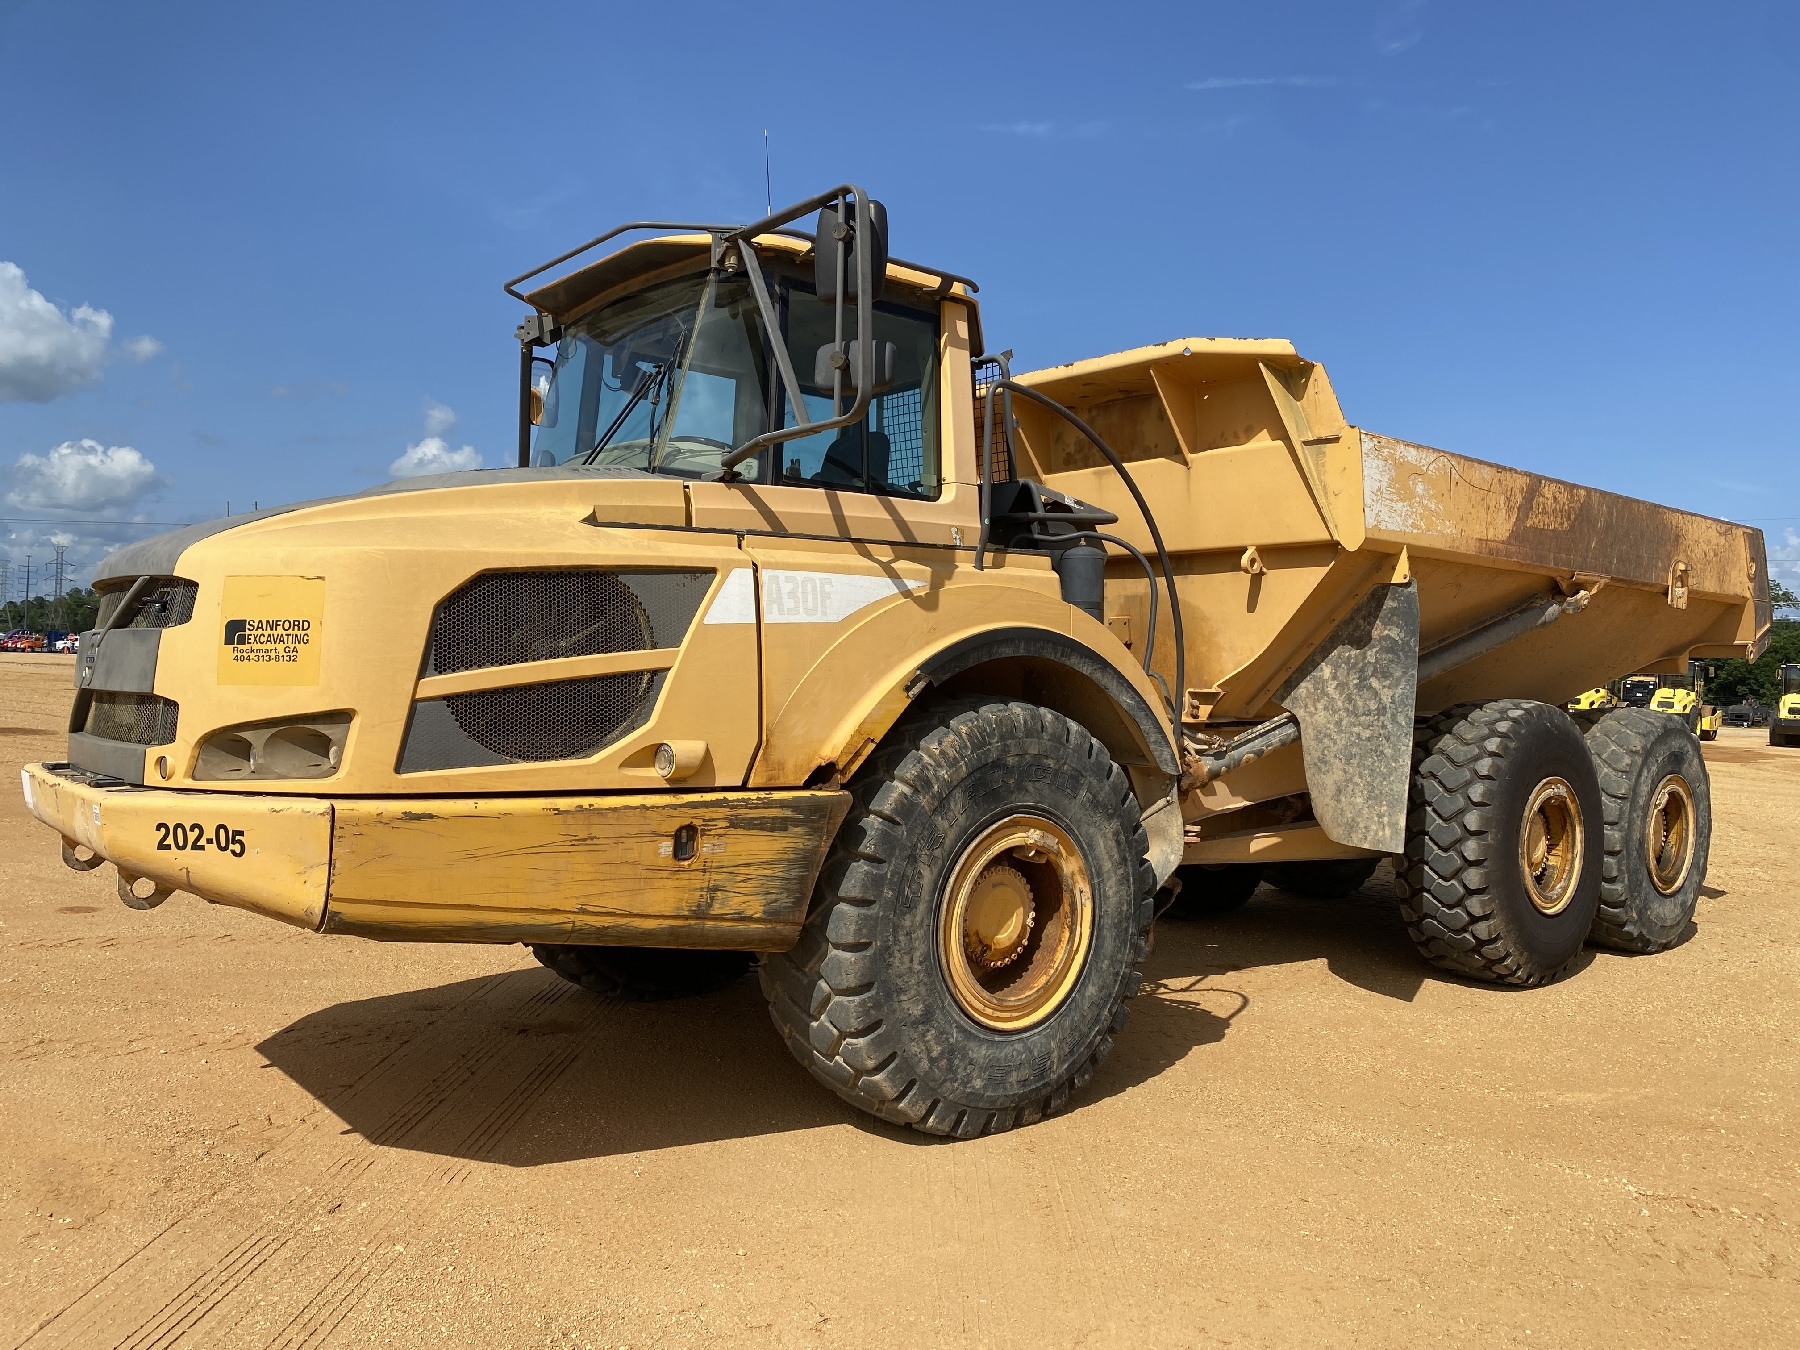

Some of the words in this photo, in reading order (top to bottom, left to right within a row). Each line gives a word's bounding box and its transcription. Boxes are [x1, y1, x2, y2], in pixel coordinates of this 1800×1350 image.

[765, 574, 833, 617] A30F
[247, 619, 311, 632] SANFORD
[246, 633, 310, 645] EXCAVATING
[232, 646, 280, 655] Rockmart,
[283, 646, 299, 654] GA
[155, 822, 246, 858] 202-05
